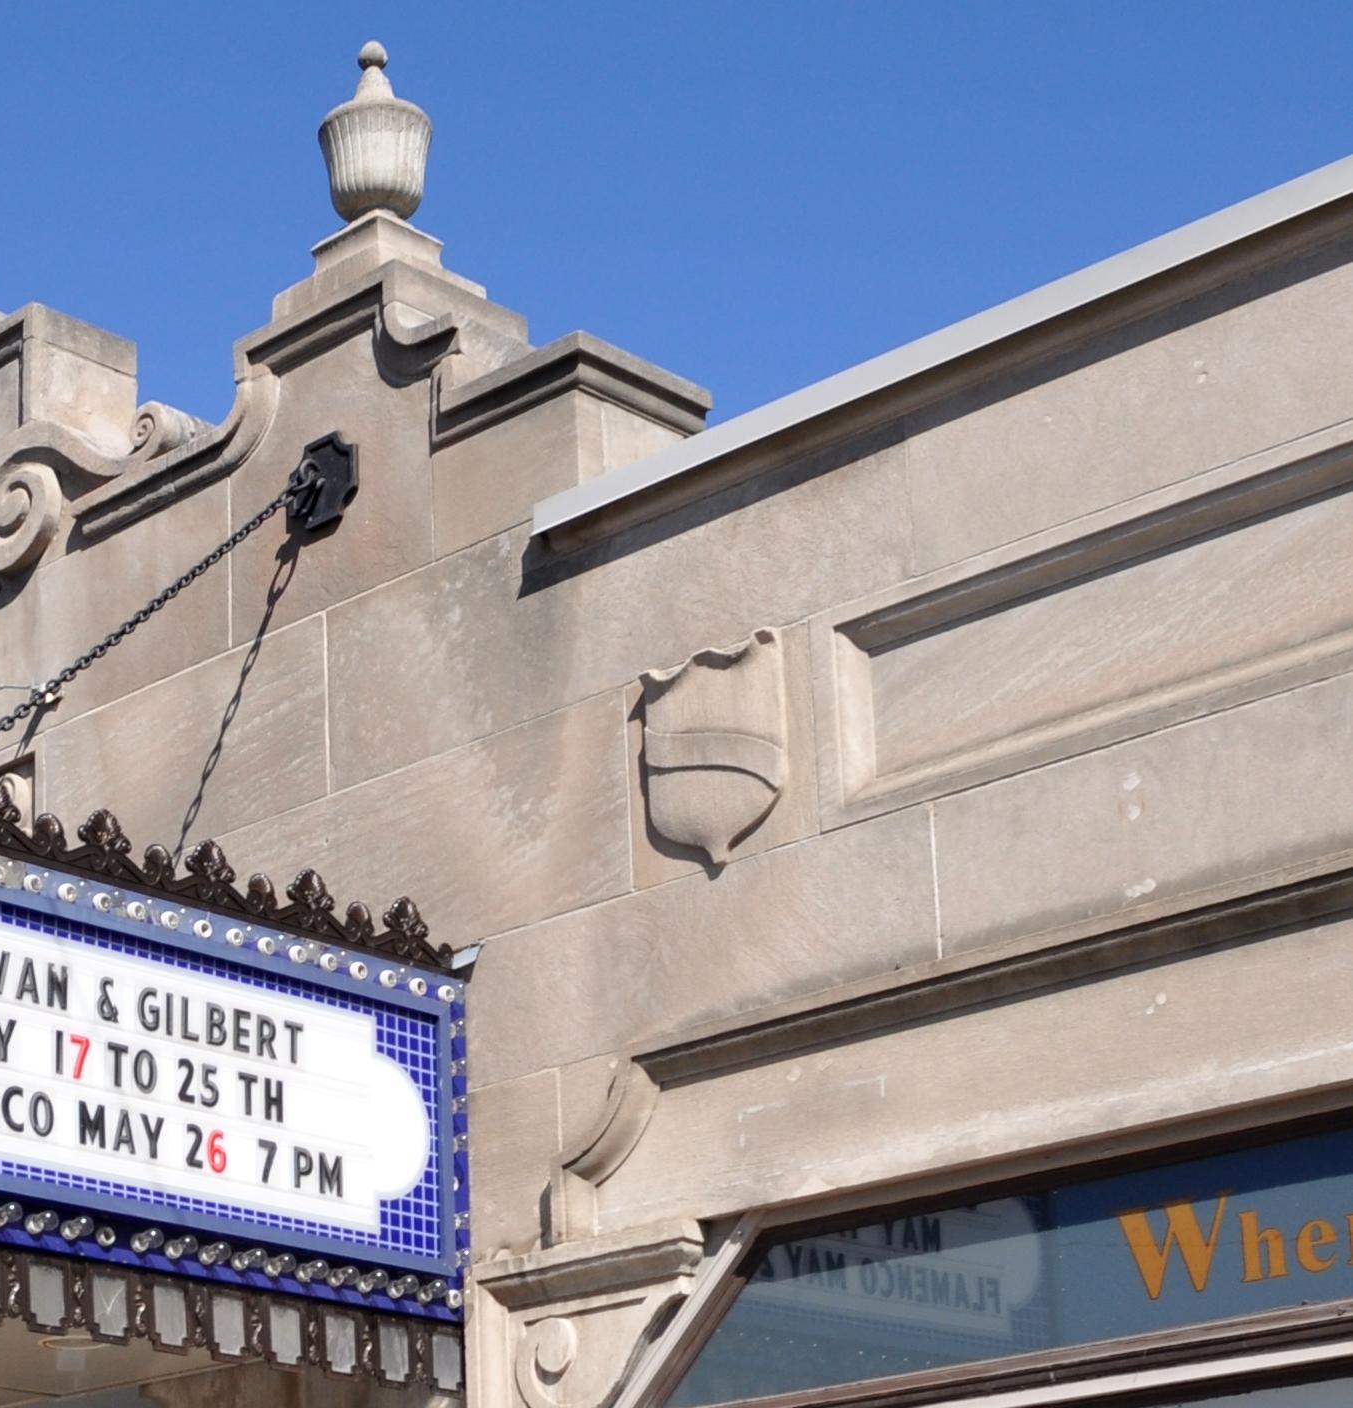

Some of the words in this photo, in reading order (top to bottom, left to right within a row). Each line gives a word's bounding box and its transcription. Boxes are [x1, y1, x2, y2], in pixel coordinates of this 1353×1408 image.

[97, 976, 119, 1022] &
[137, 987, 304, 1065] GILBERT
[54, 1030, 90, 1080] 17
[107, 1043, 157, 1094] TO
[177, 1058, 220, 1109] 25
[237, 1072, 285, 1123] TH
[77, 1100, 165, 1161] MAY
[184, 1124, 227, 1174] 26
[257, 1138, 275, 1183] 7
[293, 1146, 344, 1198] PM
[1118, 1191, 1353, 1299] Whe
